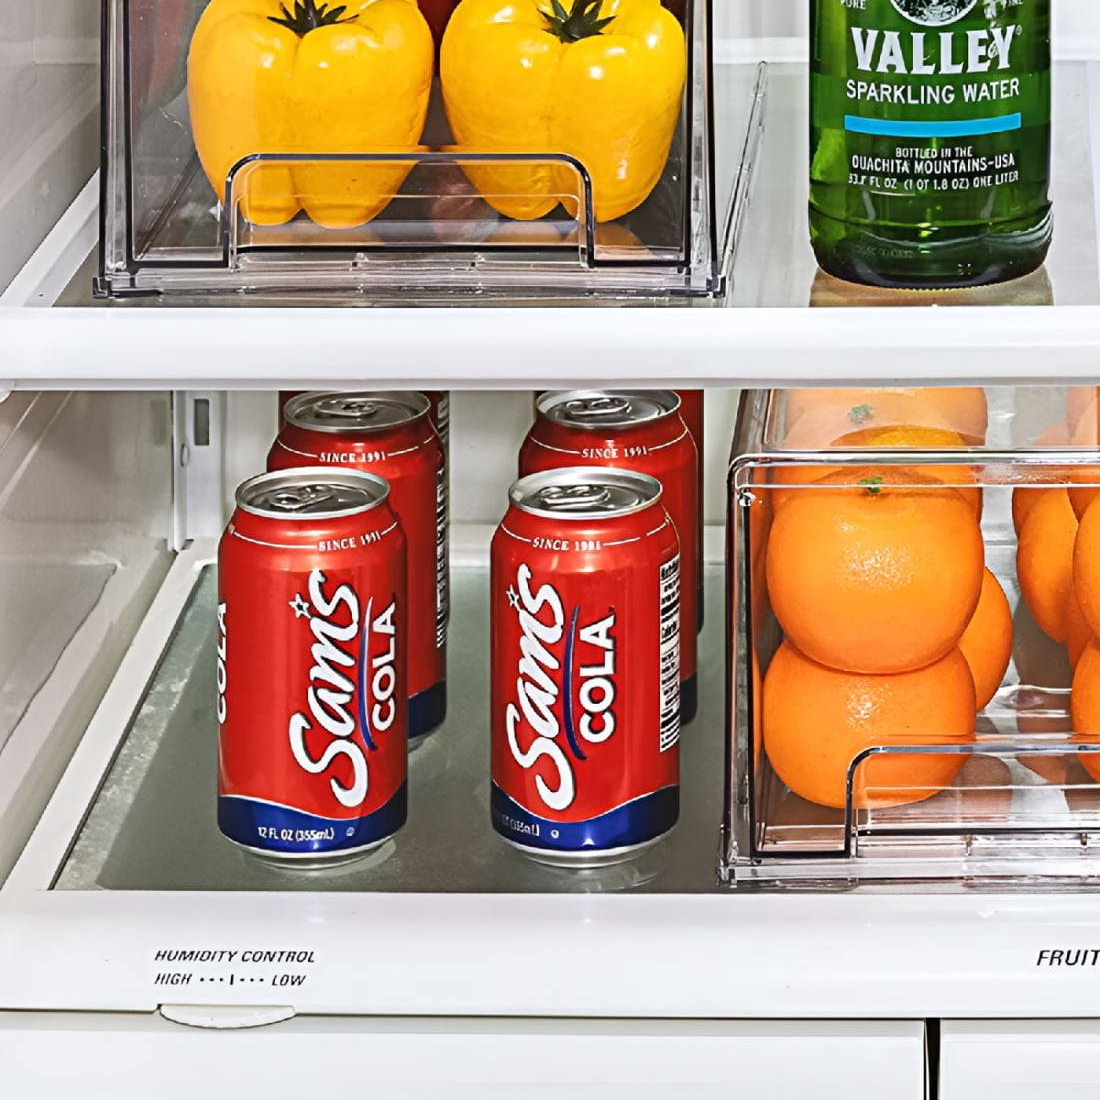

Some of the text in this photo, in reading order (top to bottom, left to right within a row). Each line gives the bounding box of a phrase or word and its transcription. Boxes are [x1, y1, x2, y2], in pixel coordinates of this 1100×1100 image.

[846, 78, 1020, 104] SPARKLING WATER
[896, 146, 973, 159] BOTTLED IN THE
[852, 152, 1015, 175] OUACHITA MOUNTAINS-USA
[869, 176, 882, 189] FL
[884, 179, 897, 190] OZ
[933, 178, 948, 191] 1.8
[319, 451, 386, 463] SINCE 1991
[582, 445, 648, 459] SINCE 1991
[318, 537, 356, 552] SINCE
[532, 537, 569, 551] SINCE
[372, 602, 397, 732] COLA
[579, 614, 617, 744] COLA
[258, 826, 267, 837] 12
[269, 828, 279, 840] FL
[281, 830, 294, 842] OZ
[154, 950, 315, 963] HUMIDITY CONTROL
[154, 973, 306, 986] HIGH LOW
